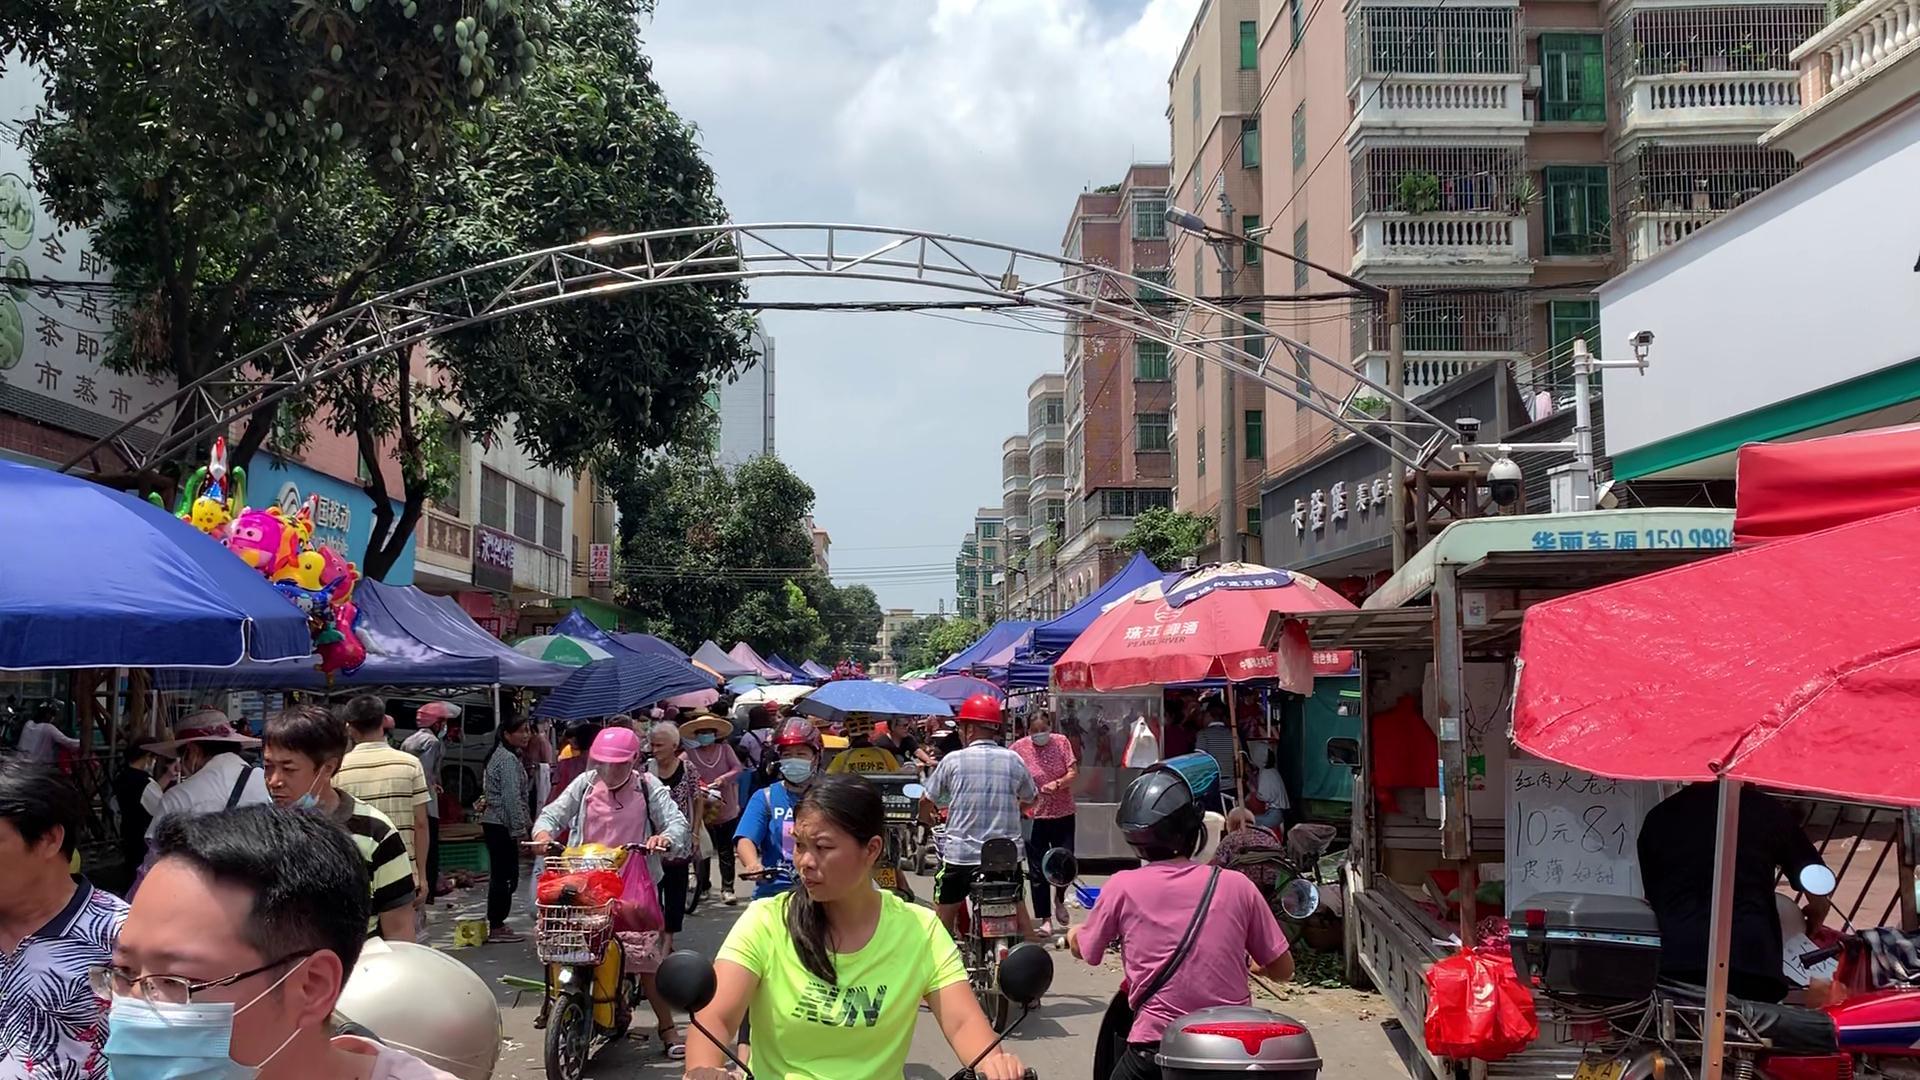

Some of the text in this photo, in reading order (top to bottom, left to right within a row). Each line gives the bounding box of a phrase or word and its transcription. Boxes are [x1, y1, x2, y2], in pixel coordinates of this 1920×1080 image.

[318, 495, 351, 532] 国移动
[1531, 530, 1638, 550] 华丽车厢
[1688, 528, 1734, 549] 998
[1124, 620, 1200, 640] 珠江啤酒
[774, 807, 794, 820] PA
